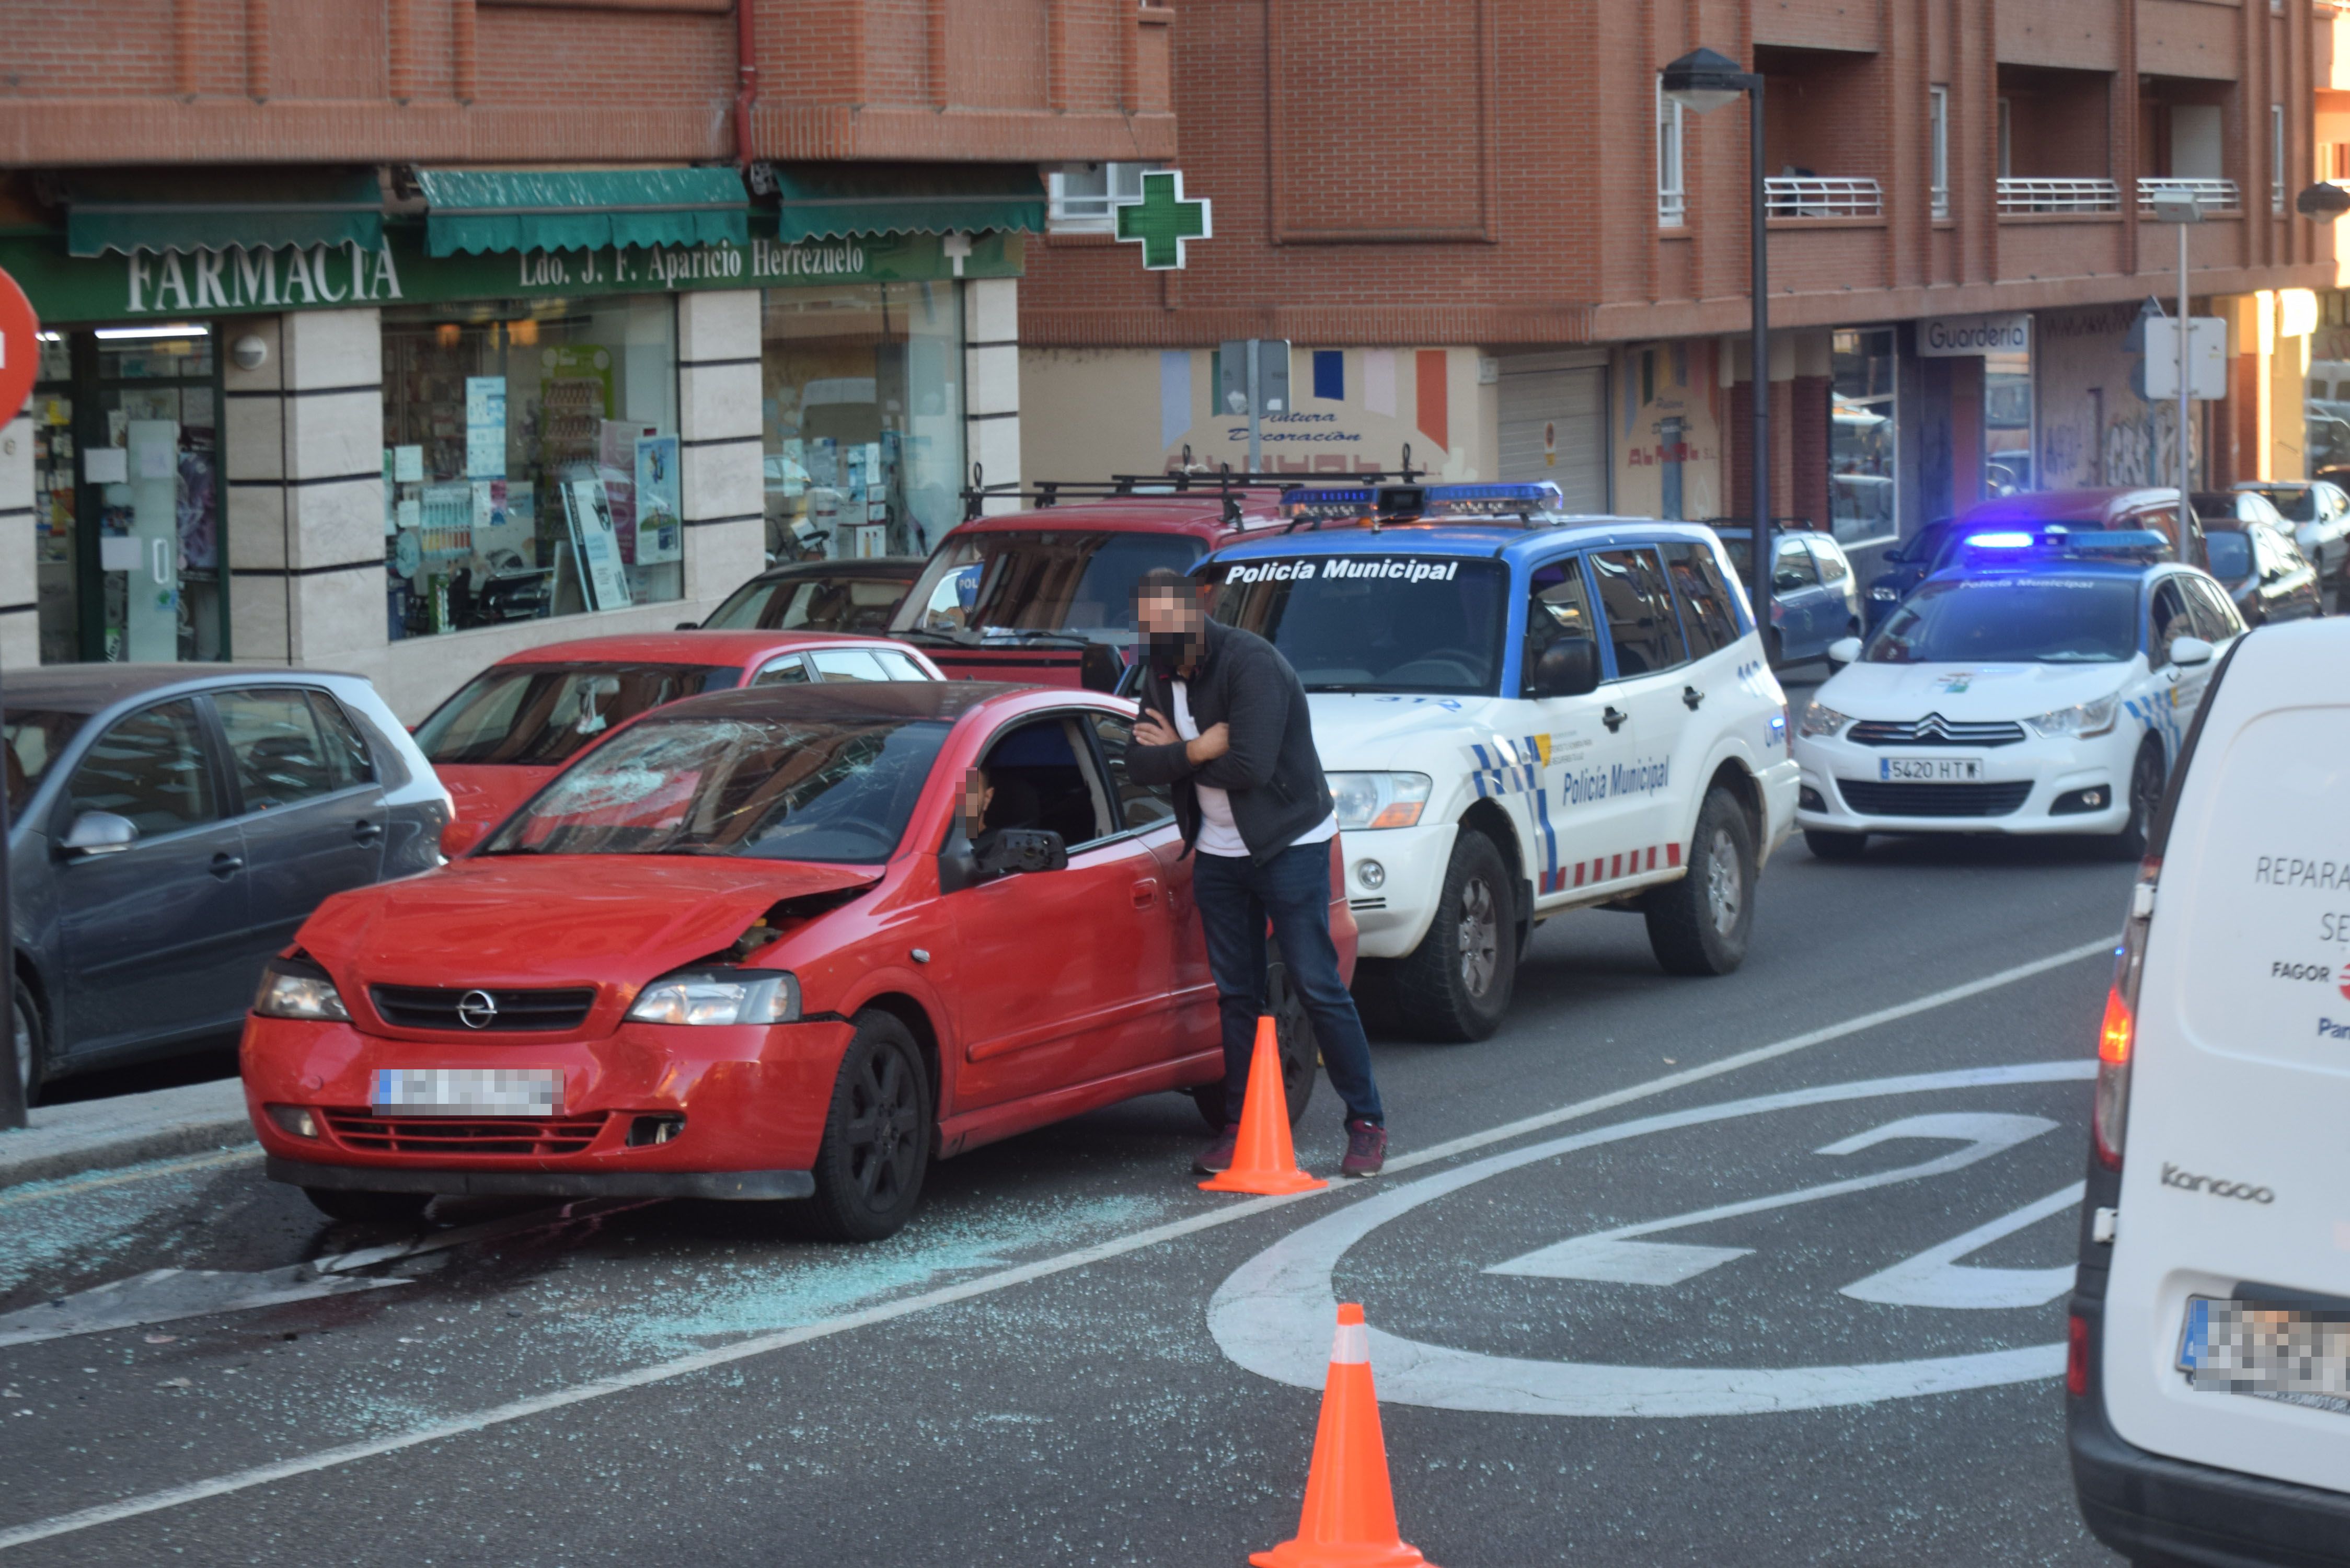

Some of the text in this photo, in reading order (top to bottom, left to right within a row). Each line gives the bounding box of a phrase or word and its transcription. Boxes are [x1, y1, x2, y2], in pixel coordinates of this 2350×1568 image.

[126, 234, 403, 312] FARMACIA
[520, 238, 865, 289] Ldo. J. F. Aparicio Herrezuelo
[1259, 411, 1338, 424] intura
[1225, 558, 1459, 585] Policía Municipal
[1562, 754, 1670, 806] Policía Municipal
[1892, 761, 1933, 778] 5420
[2270, 961, 2331, 983] FAGOR
